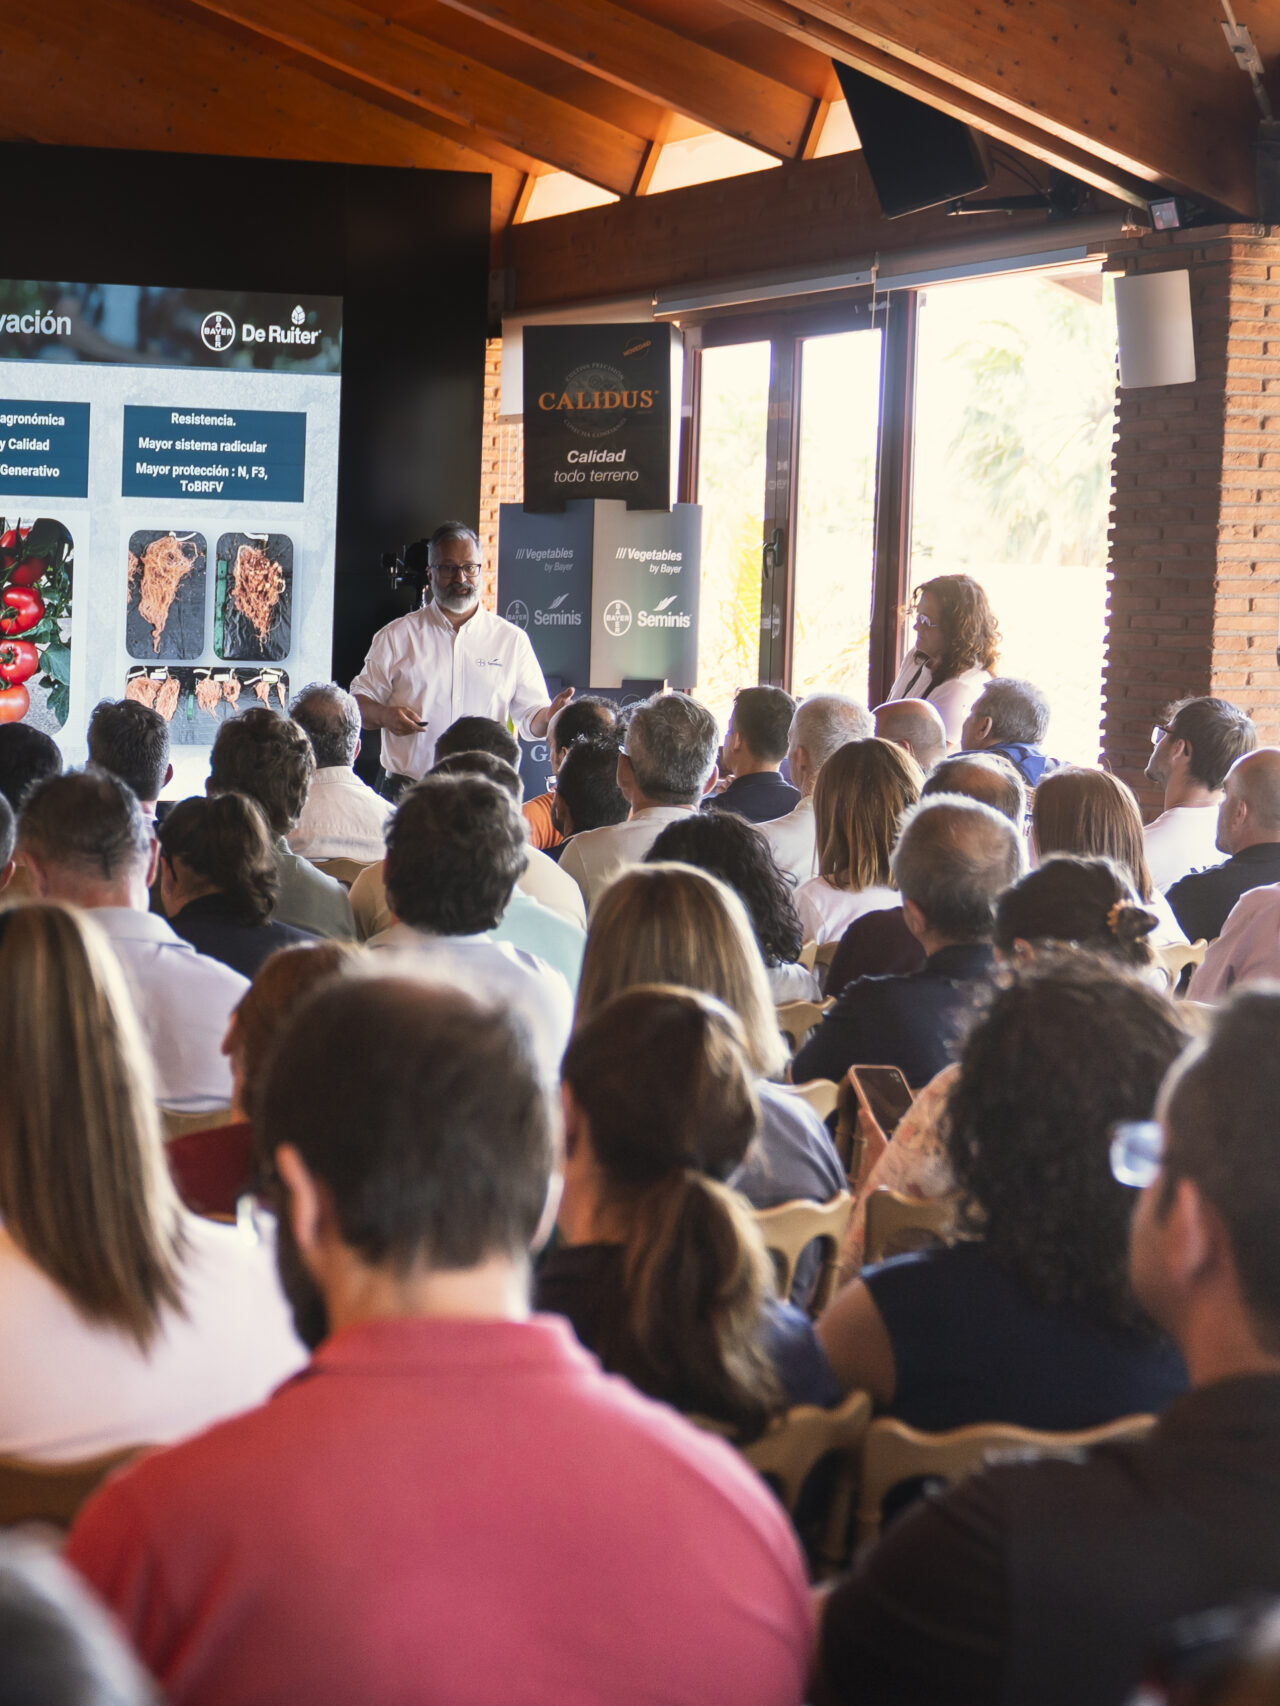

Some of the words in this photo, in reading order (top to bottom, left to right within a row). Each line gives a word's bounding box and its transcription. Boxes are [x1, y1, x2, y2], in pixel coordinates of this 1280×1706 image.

[242, 323, 266, 342] De
[268, 325, 319, 344] Ruiter
[538, 390, 653, 411] CALIDUS
[0, 412, 65, 427] agronómica
[171, 412, 236, 427] Resistencia.
[0, 440, 6, 452] y
[8, 438, 50, 451] Calidad
[138, 437, 173, 452] Mayor
[175, 438, 218, 451] sistema
[220, 440, 267, 453] radicular
[567, 449, 626, 464] Calidad
[135, 462, 170, 477] Mayor
[172, 464, 229, 478] protección
[237, 466, 249, 480] N,
[251, 466, 268, 481] F3,
[554, 469, 586, 483] todo
[590, 469, 639, 483] terreno
[180, 480, 224, 493] ToBRFV
[526, 548, 574, 562] Vegetables
[628, 548, 682, 563] Vegetables
[544, 562, 553, 573] by
[554, 563, 573, 574] Bayer
[649, 563, 659, 574] by
[660, 563, 682, 574] Bayer
[534, 609, 582, 625] Seminis
[637, 610, 691, 628] Seminis
